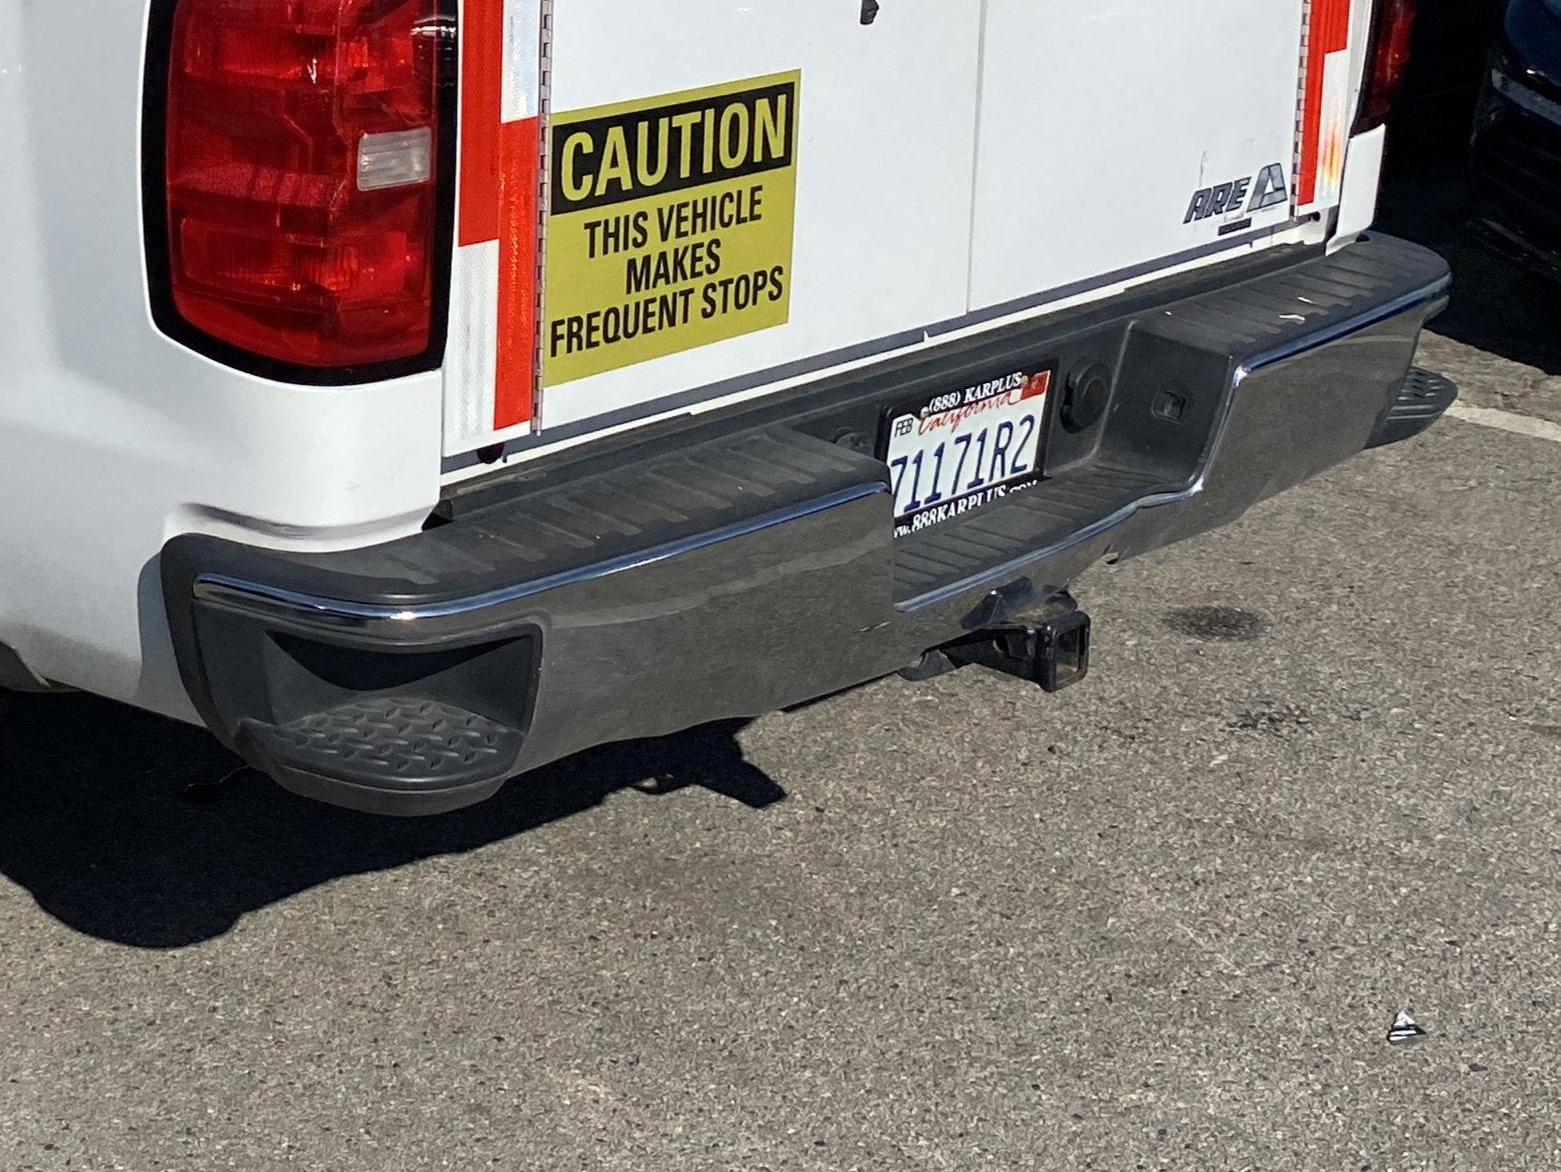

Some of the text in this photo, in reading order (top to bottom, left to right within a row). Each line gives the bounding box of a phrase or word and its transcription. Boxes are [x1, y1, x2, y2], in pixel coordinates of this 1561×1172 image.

[560, 93, 787, 202] CAUTION
[583, 184, 764, 259] THIS VEHICLE
[625, 238, 722, 295] MAKES
[549, 265, 785, 359] FREQUENT STOPS
[918, 391, 1021, 436] California
[928, 391, 961, 412] (888)
[963, 371, 1023, 402] KARPLUS
[894, 417, 914, 437] FEB
[890, 414, 1036, 514] 71171R2
